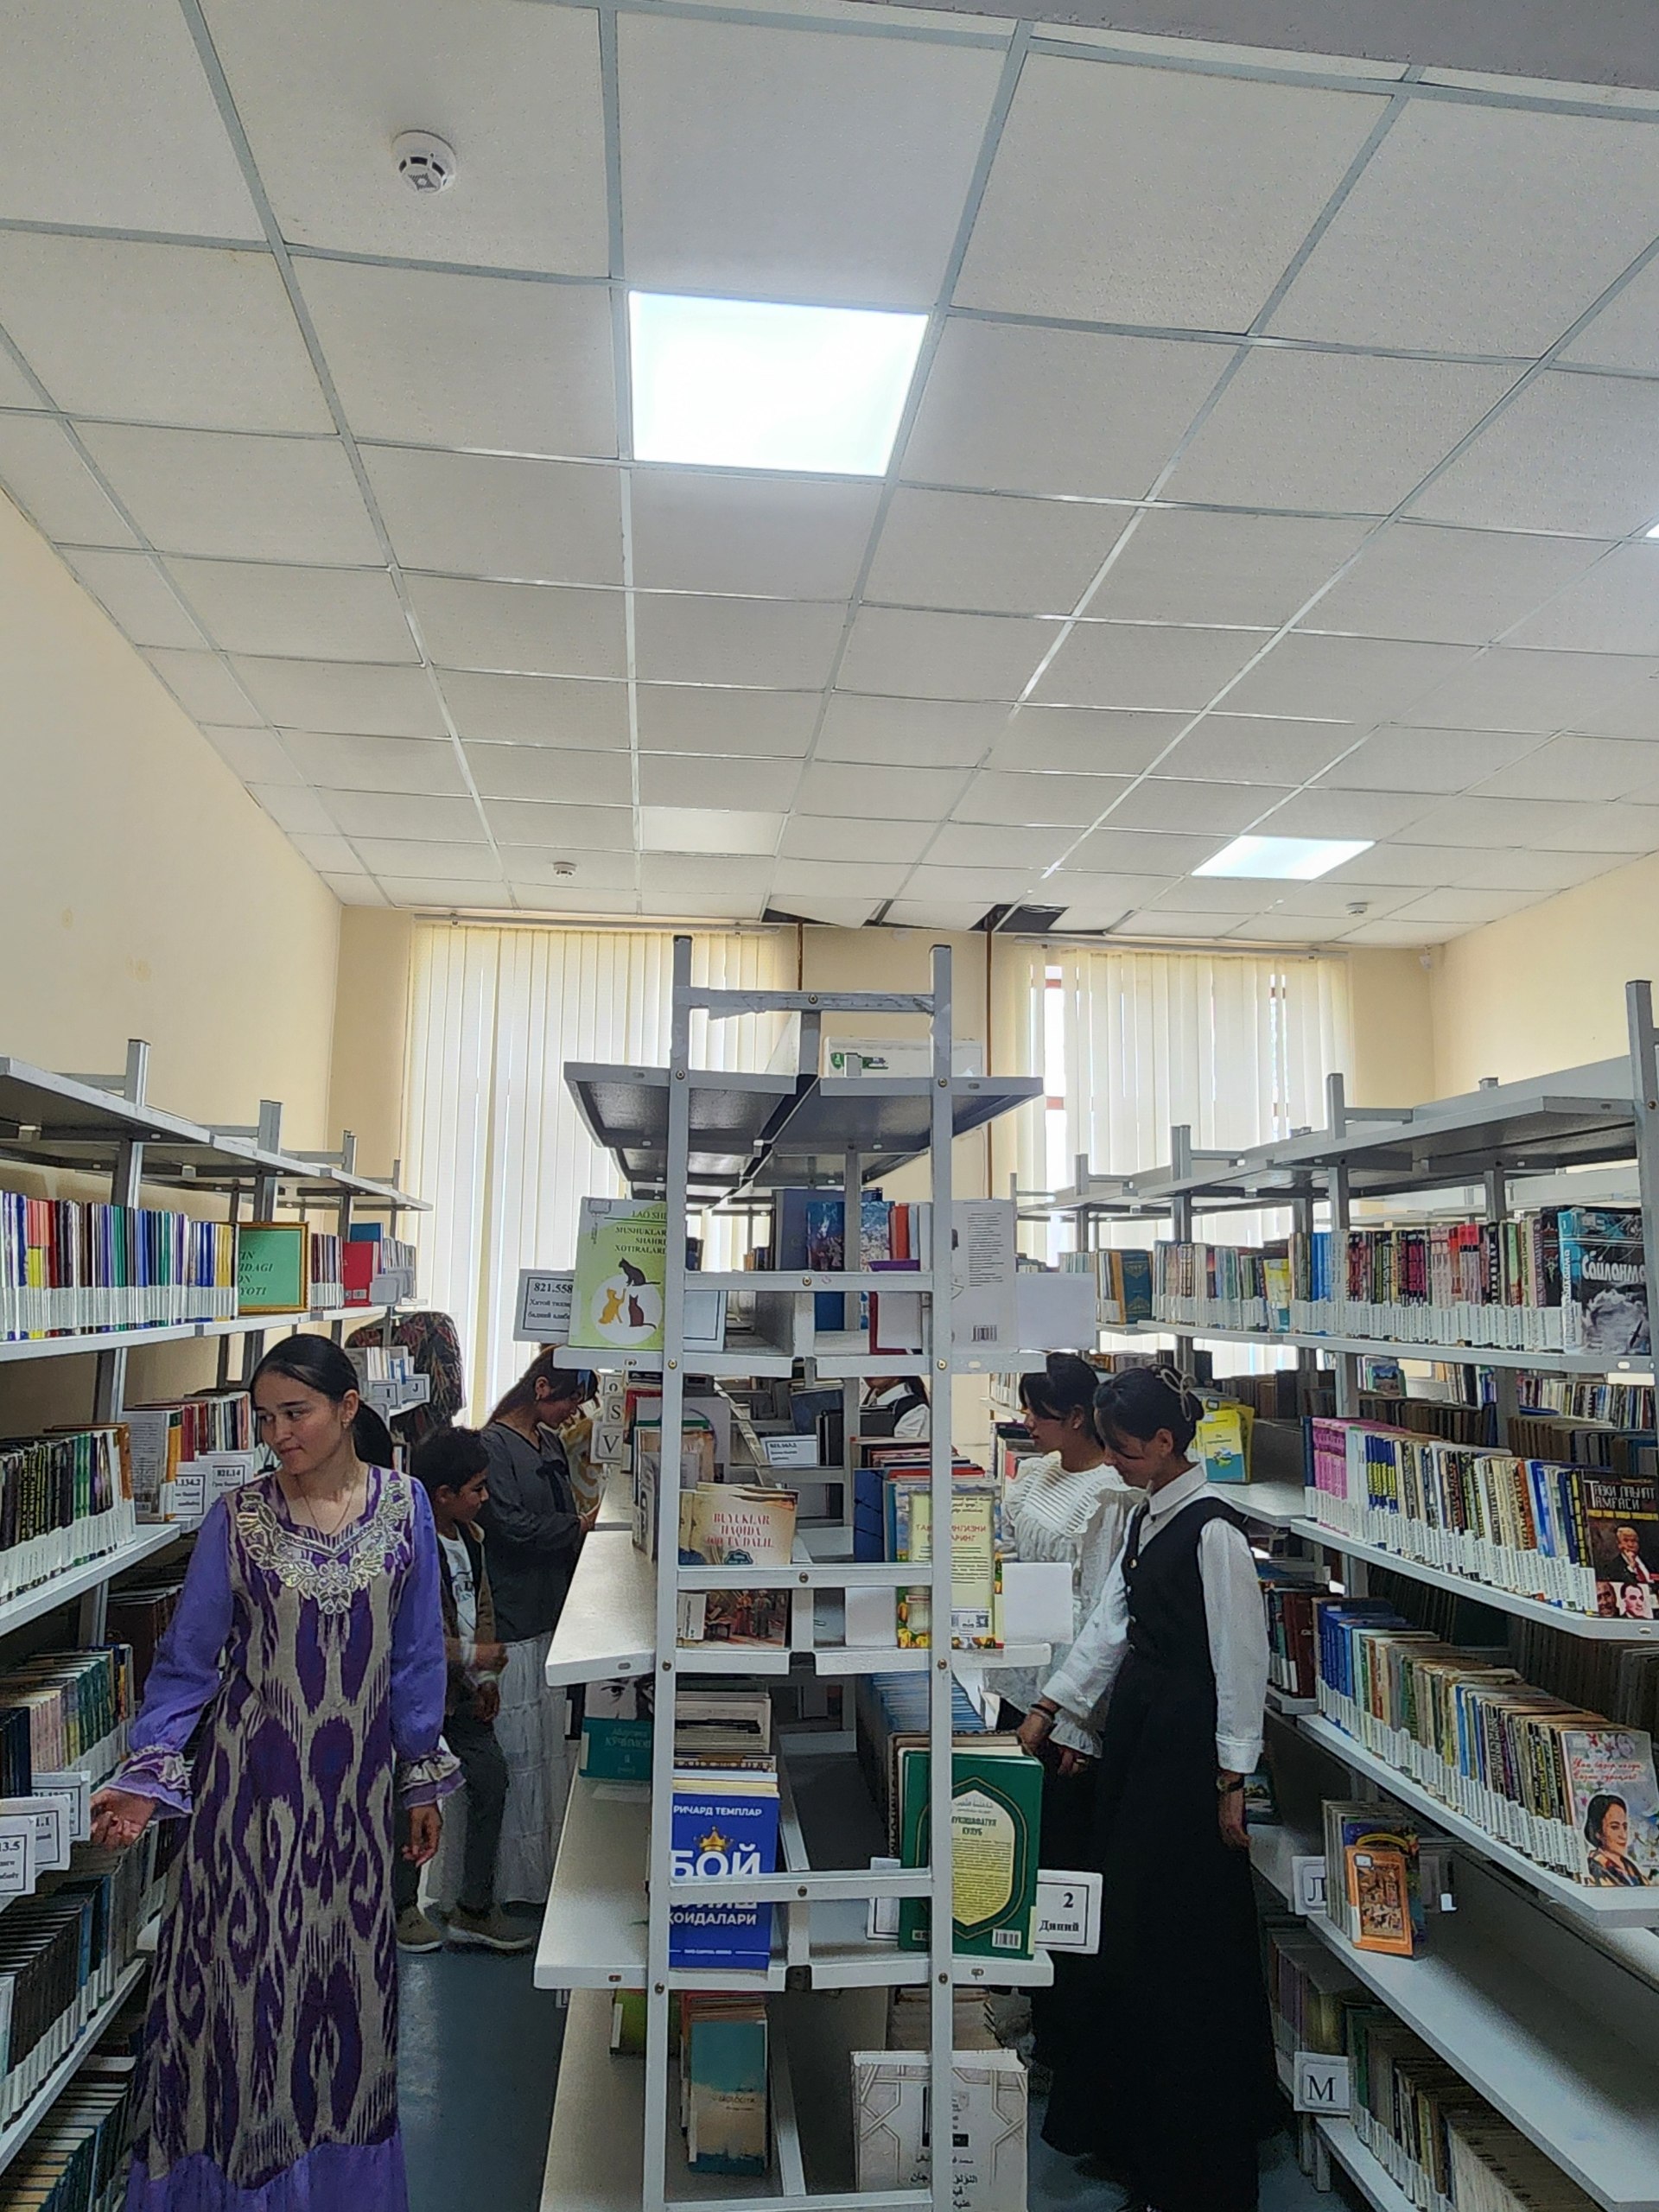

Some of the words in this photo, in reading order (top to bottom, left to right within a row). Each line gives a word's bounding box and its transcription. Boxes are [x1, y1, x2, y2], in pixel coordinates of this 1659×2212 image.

[611, 1404, 621, 1420] S
[602, 1434, 620, 1453] V
[674, 1805, 713, 1815] РИЧАРД
[715, 1807, 762, 1816] ТЕМПЛАР
[671, 1843, 760, 1878] БОЙ
[1063, 1892, 1074, 1908] 2
[1306, 2075, 1336, 2102] М
